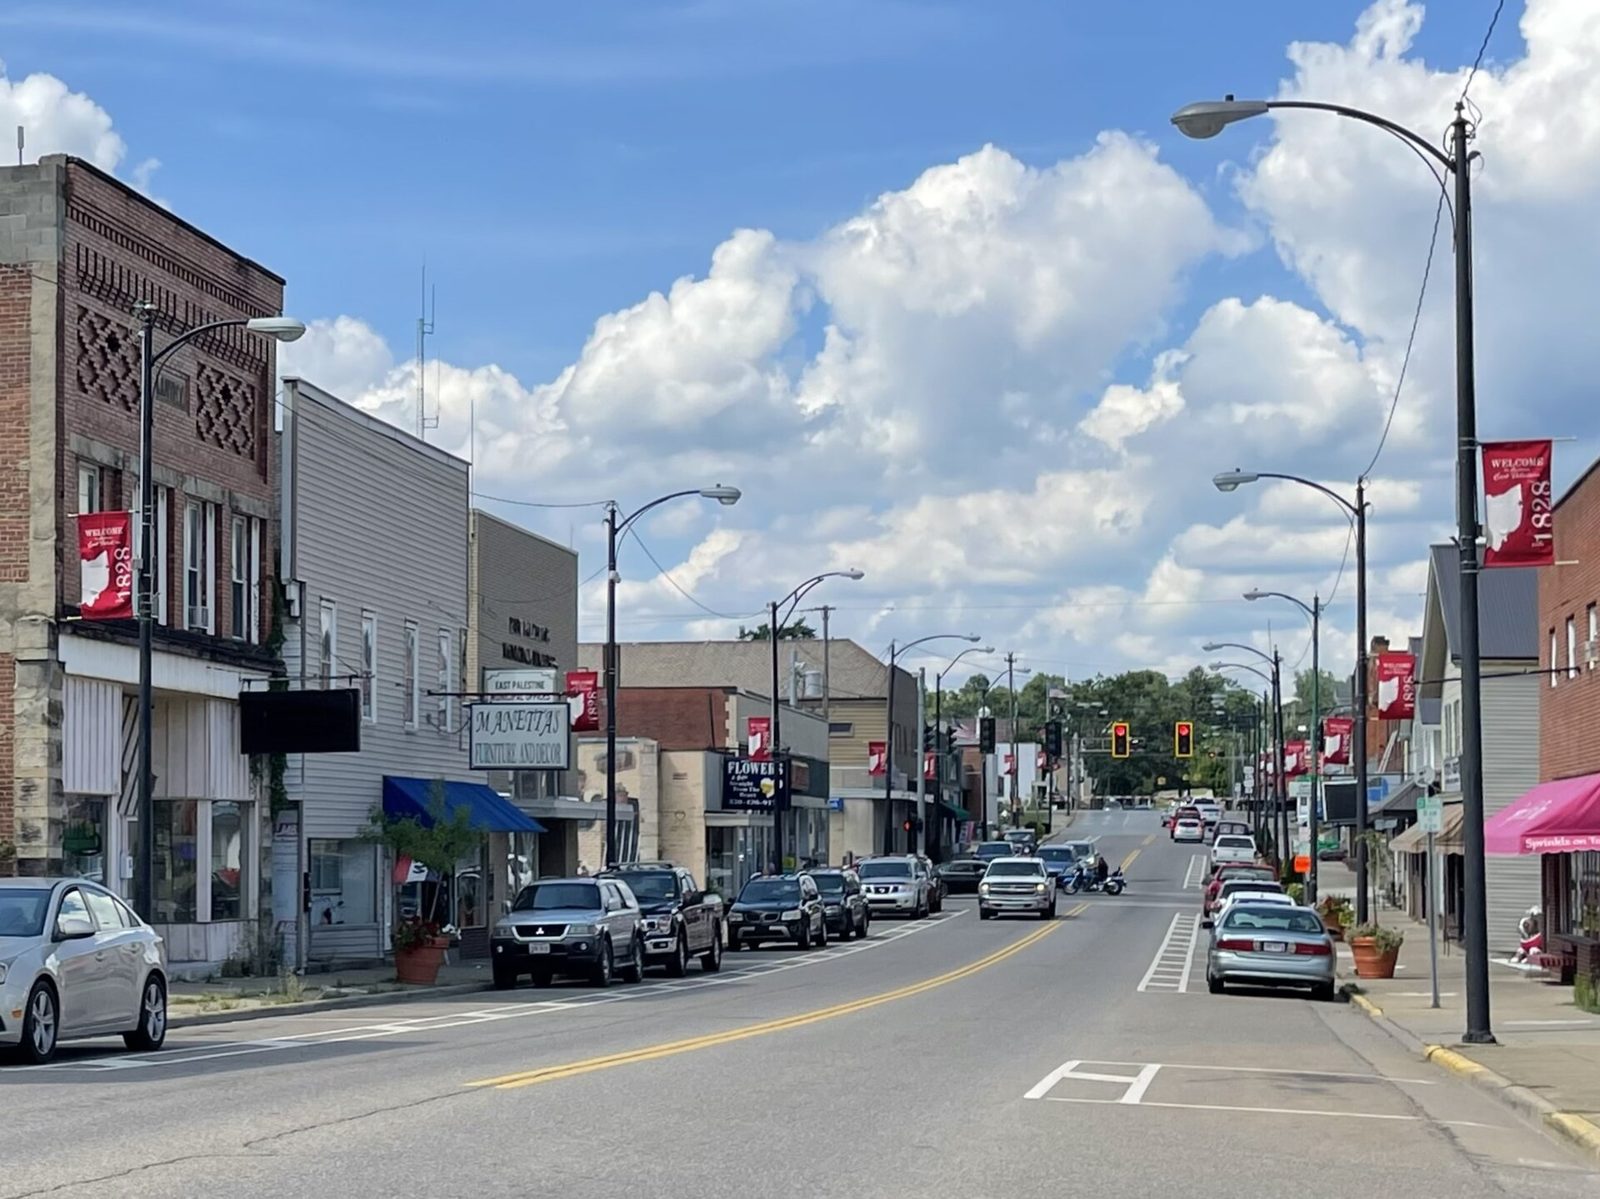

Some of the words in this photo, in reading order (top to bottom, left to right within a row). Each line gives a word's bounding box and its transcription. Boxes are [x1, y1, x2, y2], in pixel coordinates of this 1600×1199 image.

[1491, 457, 1544, 468] WELCOME
[1531, 481, 1552, 541] 1828
[85, 527, 124, 537] WELCOME
[114, 547, 131, 599] 1828
[495, 681, 510, 690] EAST
[512, 681, 545, 690] PALESTINE
[475, 708, 561, 737] MANETTAS
[535, 742, 562, 764] DECOR
